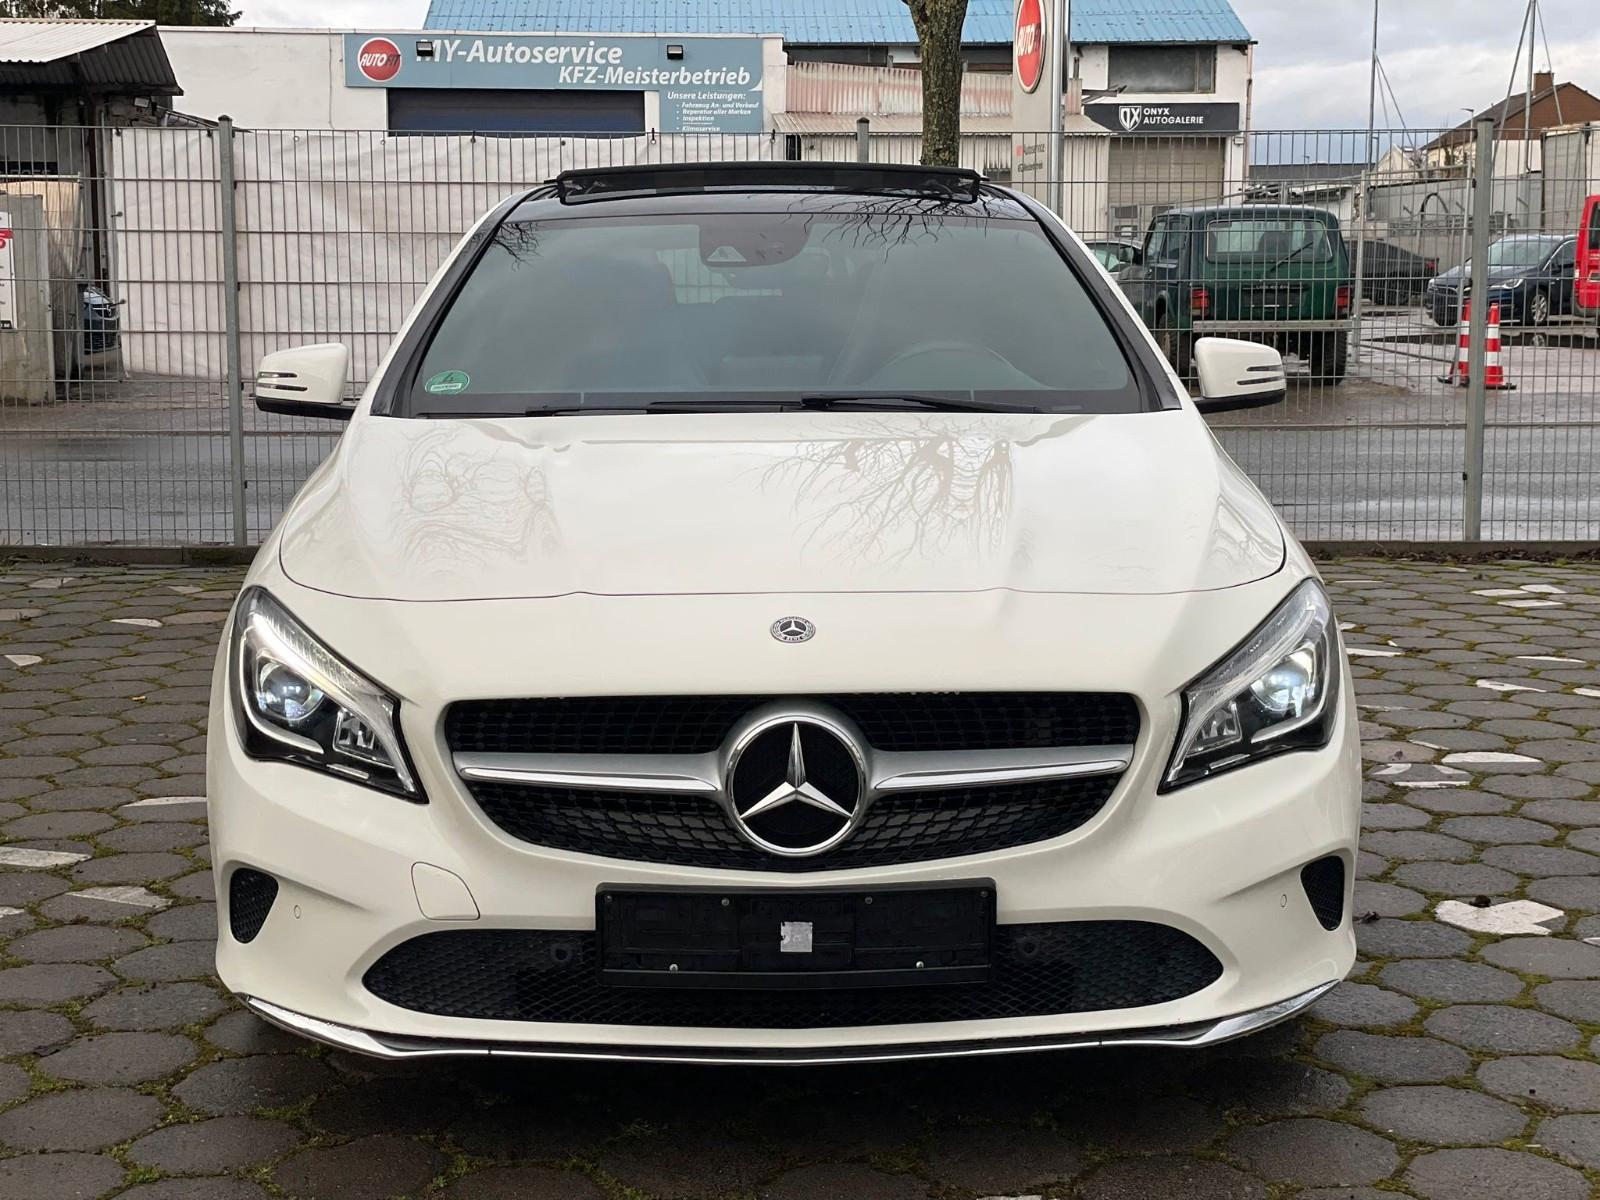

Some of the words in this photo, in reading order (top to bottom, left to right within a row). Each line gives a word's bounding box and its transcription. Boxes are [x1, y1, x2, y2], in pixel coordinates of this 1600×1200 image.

[559, 66, 750, 84] KFZ-Meisterbetrieb
[667, 91, 696, 100] Unsere
[697, 91, 747, 101] Leistungen:
[1143, 107, 1170, 115] ONYX
[1143, 116, 1204, 124] AUTOGALERIE
